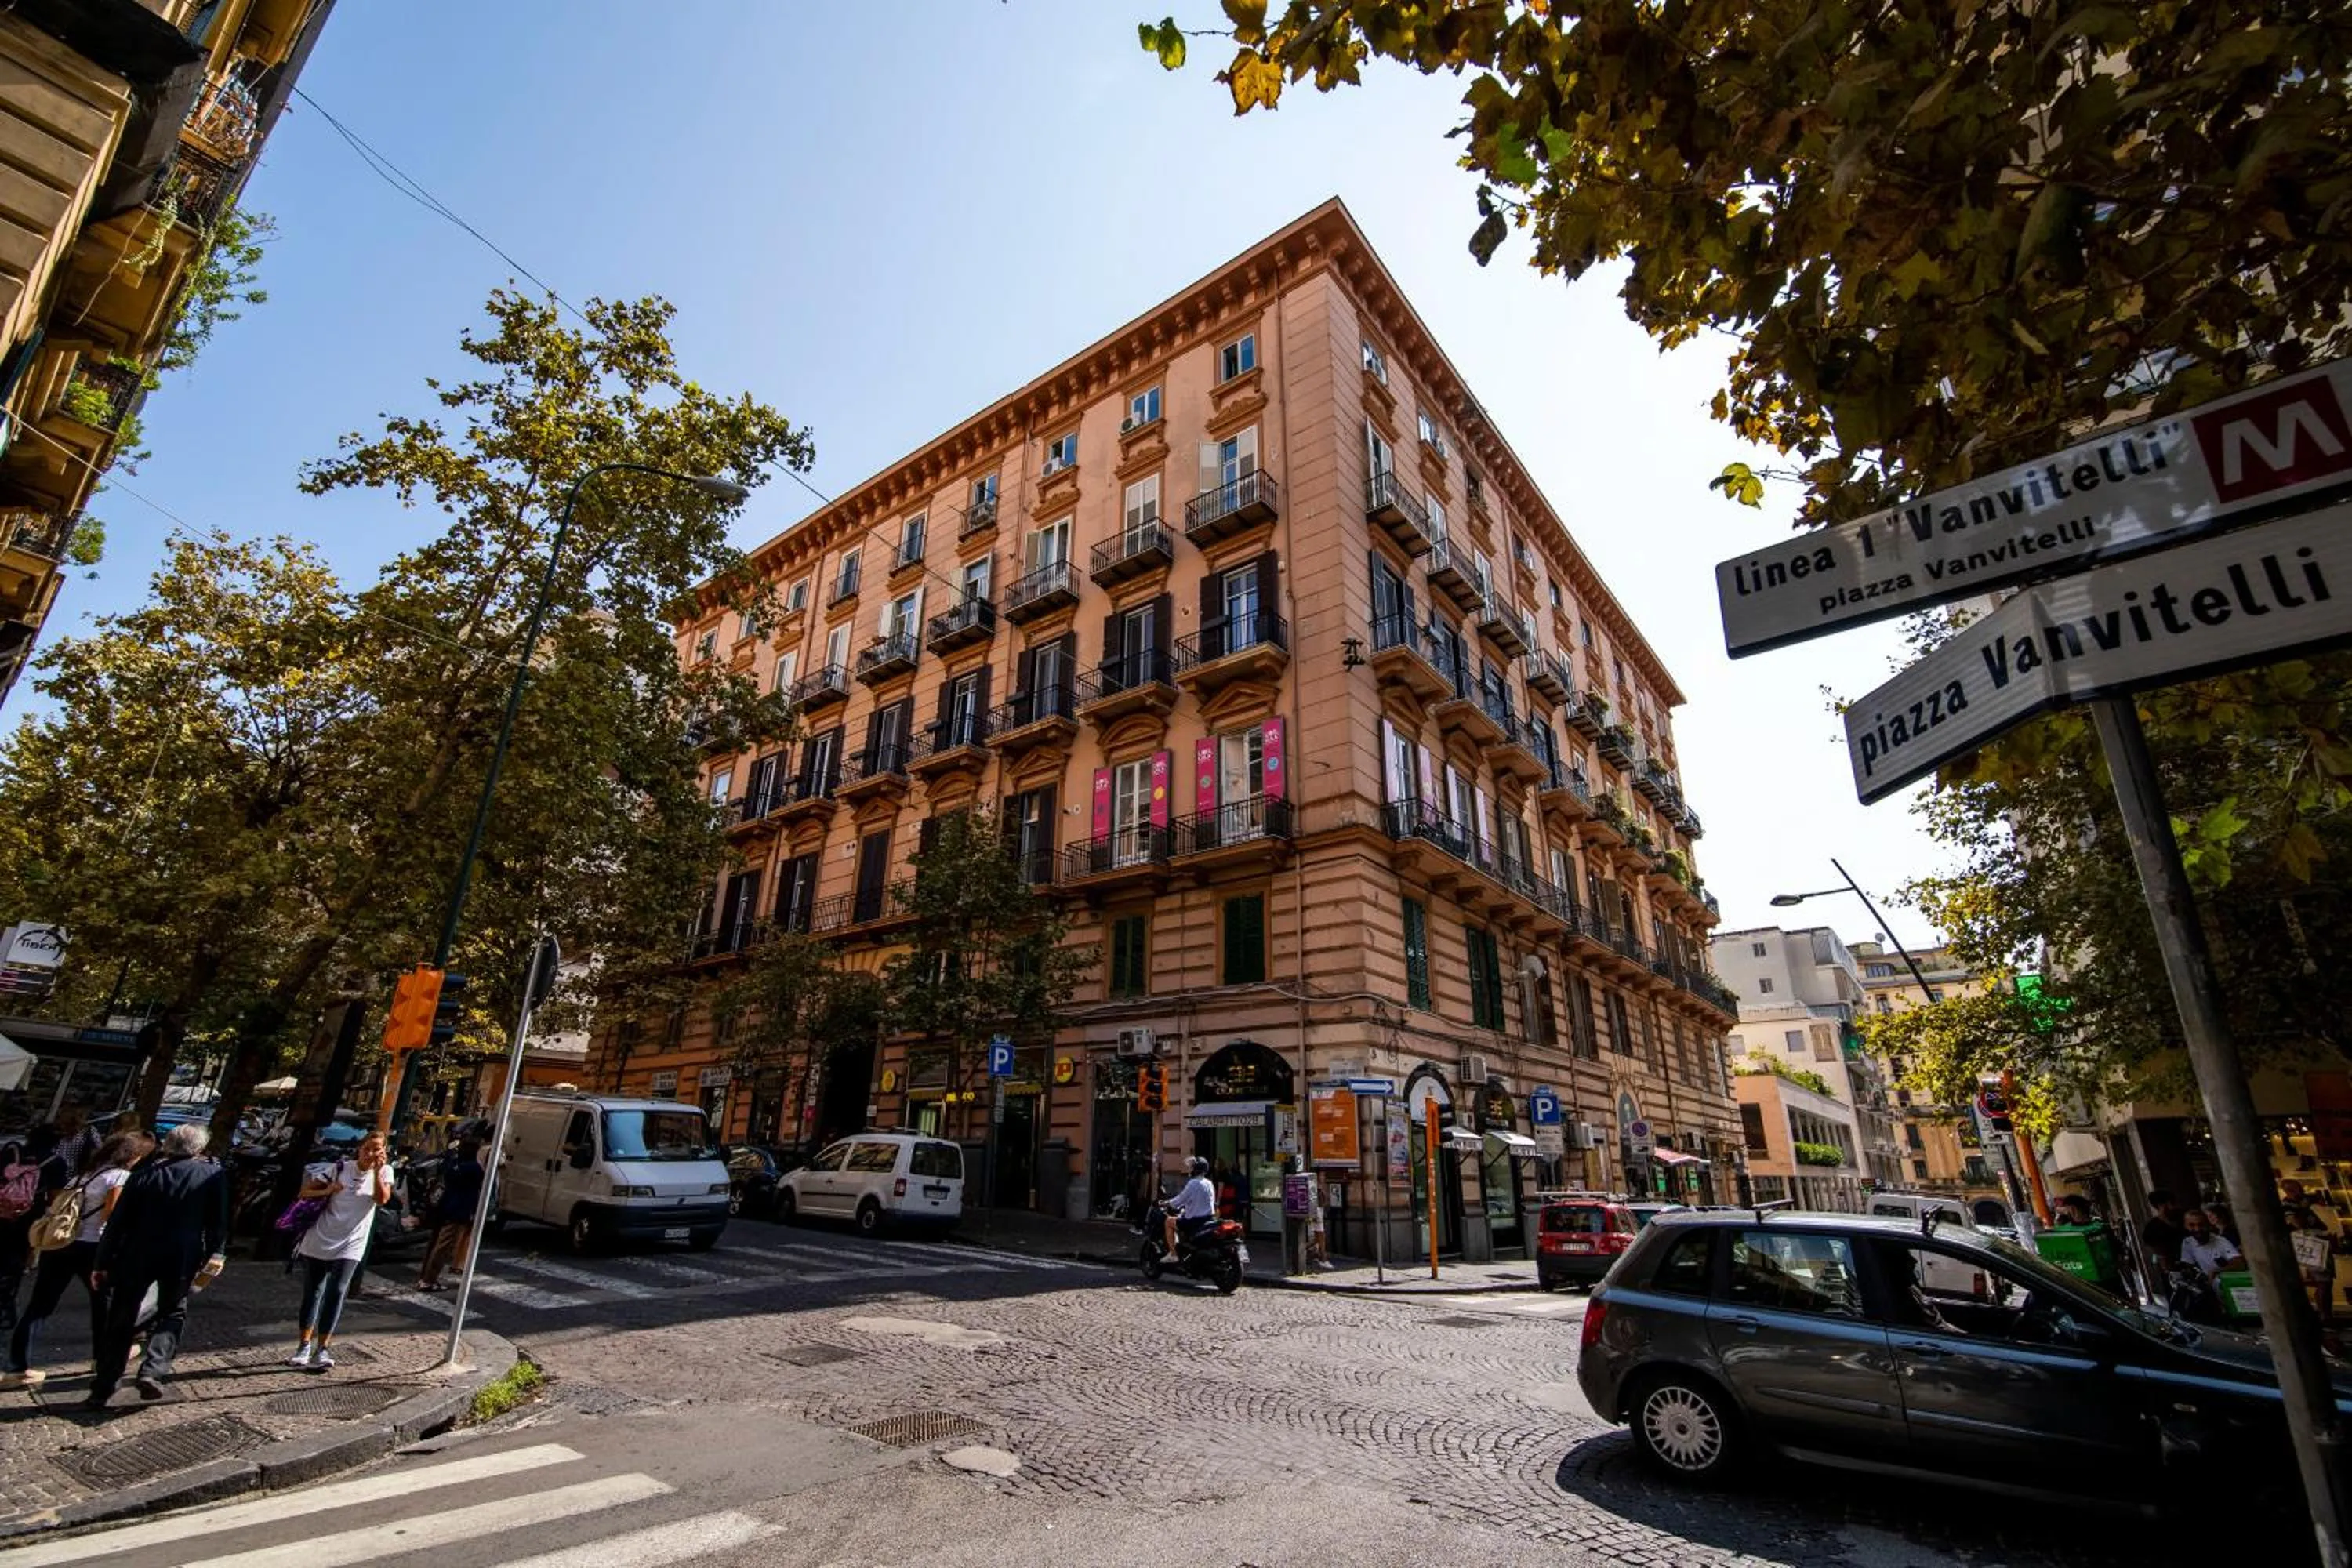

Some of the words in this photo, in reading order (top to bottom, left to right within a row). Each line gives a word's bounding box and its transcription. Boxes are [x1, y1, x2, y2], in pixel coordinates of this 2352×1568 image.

[2220, 398, 2345, 485] M
[1856, 528, 1875, 560] 1
[1886, 423, 2181, 543] "Vanvitelli"
[1819, 571, 1915, 615] piazza
[1924, 516, 2096, 581] Vanvitelli
[1859, 677, 1969, 778] piazza
[1980, 546, 2332, 691] Vanvitelli
[993, 1047, 1008, 1072] P
[1536, 1098, 1553, 1120] P
